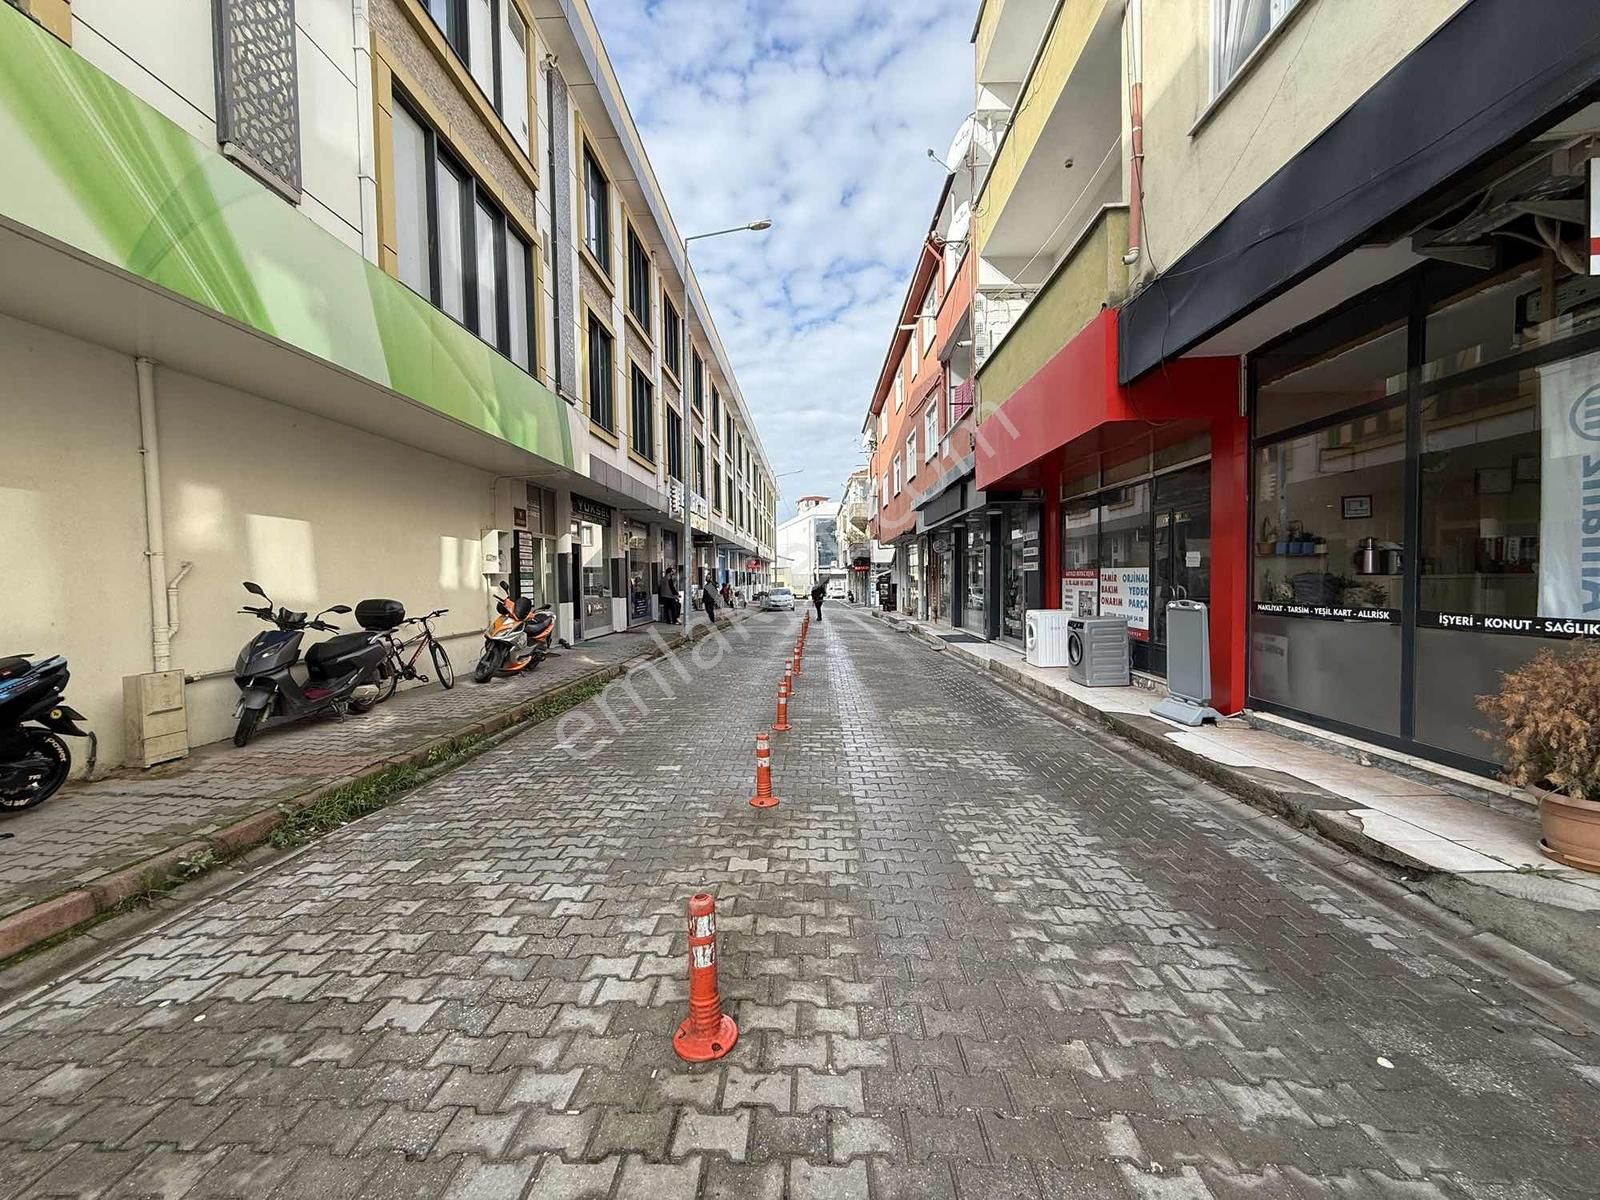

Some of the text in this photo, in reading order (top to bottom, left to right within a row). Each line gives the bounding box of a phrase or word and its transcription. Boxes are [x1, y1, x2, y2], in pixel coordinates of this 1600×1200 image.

[1101, 571, 1148, 583] TAMİR ORJİNAL
[1101, 585, 1148, 597] BAKIM YEDEK
[1101, 597, 1148, 611] ONARIM PARÇA
[1288, 604, 1309, 614] TARSİM
[1314, 606, 1332, 617] YEŞİL
[1333, 608, 1352, 617] KART
[1358, 609, 1390, 620] ALLRİSK
[1439, 613, 1473, 627] İŞYERİ
[1484, 618, 1532, 630] KONUT
[1544, 620, 1600, 635] SAĞLIK
